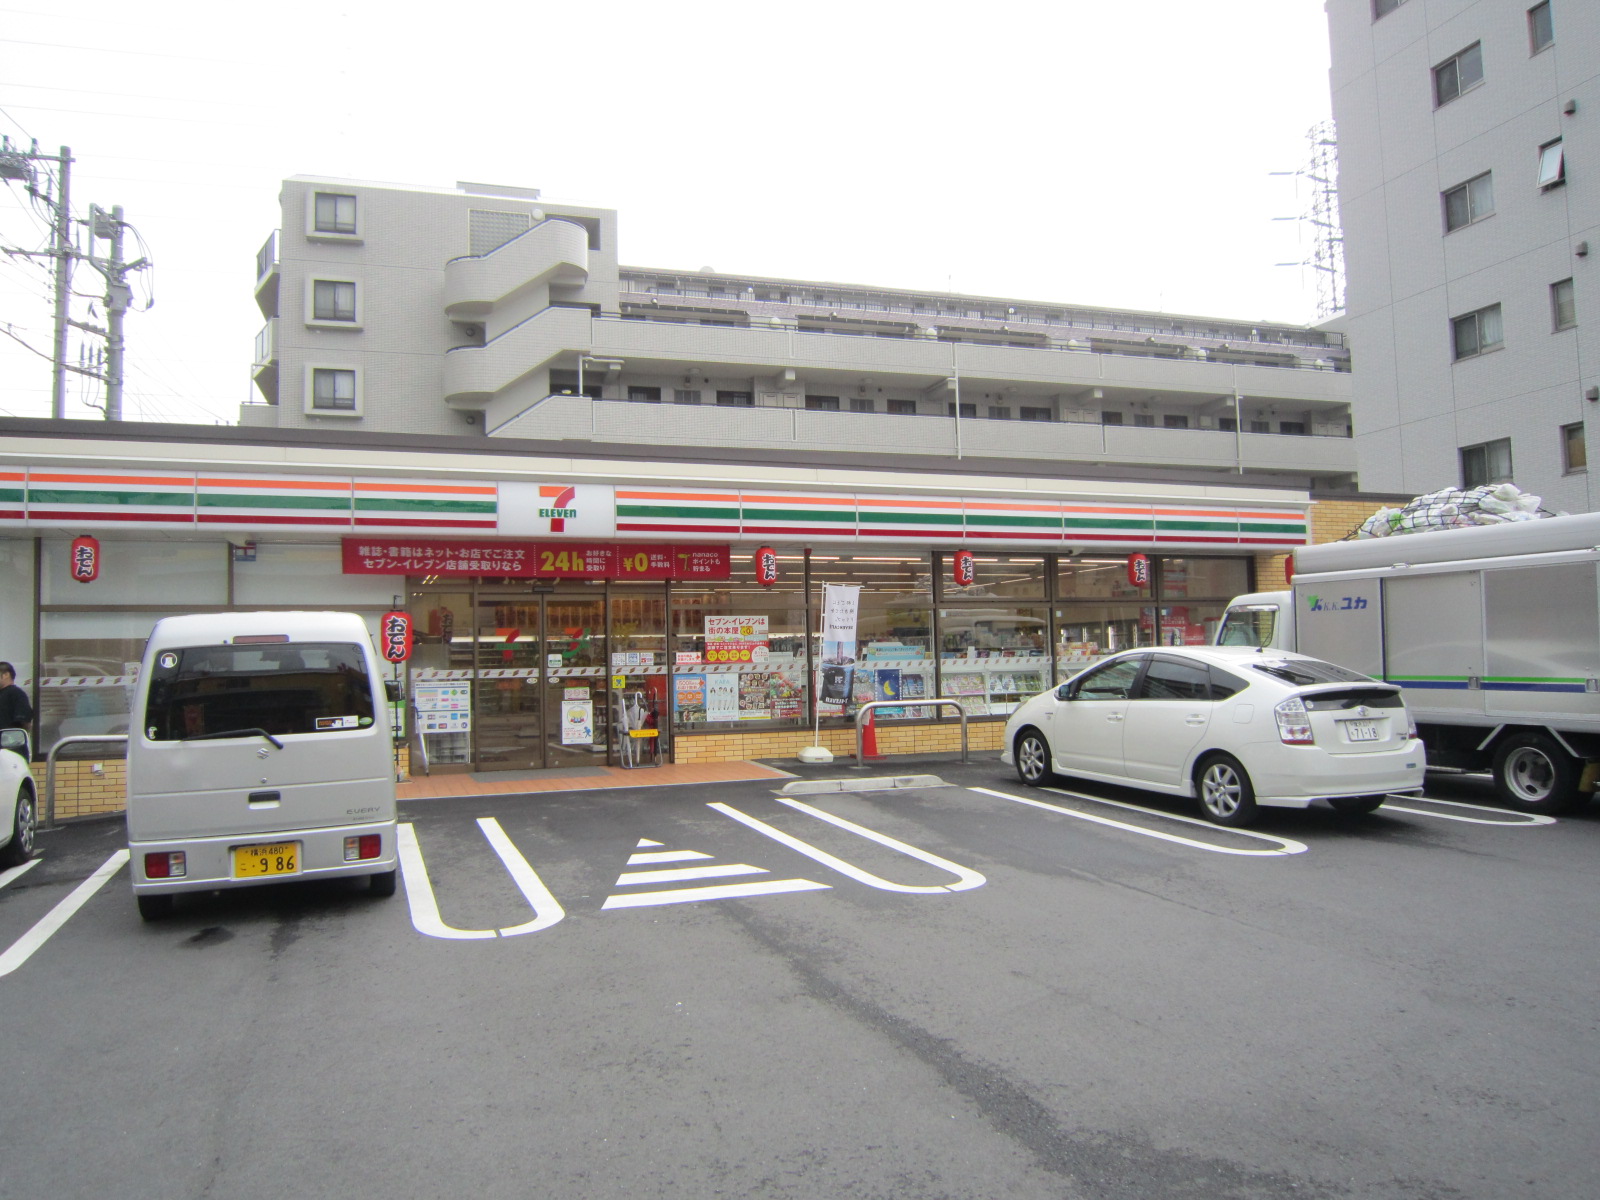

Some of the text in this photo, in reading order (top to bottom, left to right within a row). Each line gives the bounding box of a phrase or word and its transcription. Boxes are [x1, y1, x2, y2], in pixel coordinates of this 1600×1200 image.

[75, 546, 94, 577] おでん
[358, 546, 525, 560] 雑誌・書籍はネット・お店でご注文
[540, 551, 585, 572] 24h
[586, 557, 606, 565] 時間に
[623, 552, 649, 572] ¥0
[586, 564, 606, 572] 受取り
[762, 553, 776, 580] おでん
[961, 556, 973, 581] おでん
[1134, 559, 1146, 582] おでん
[1341, 596, 1367, 609] ユカ
[386, 616, 407, 659] おでん
[346, 806, 381, 815] EVERY
[268, 846, 284, 855] 480
